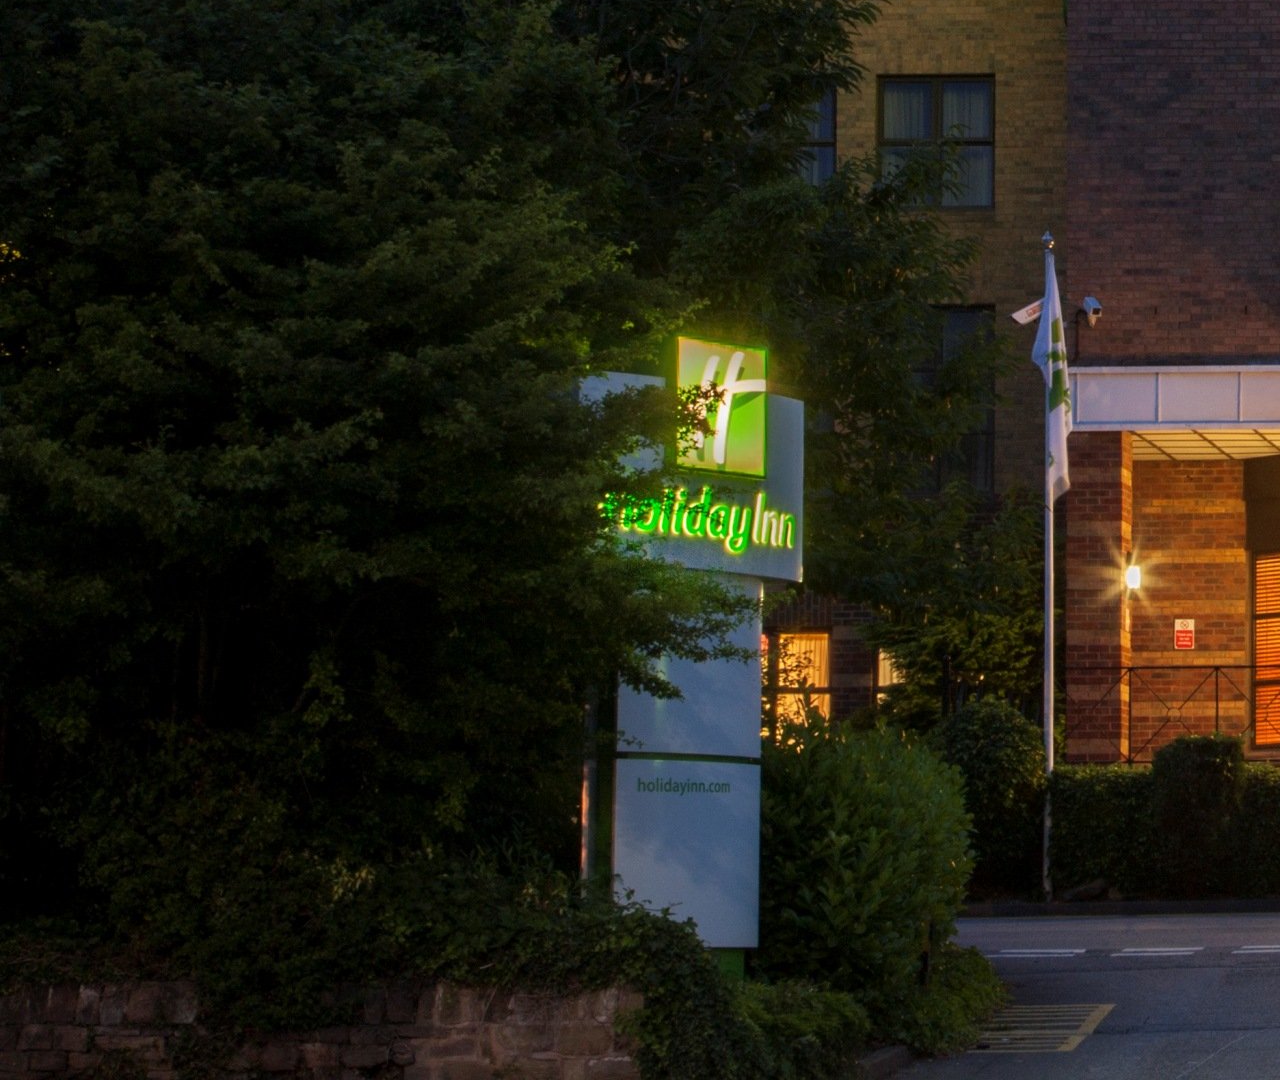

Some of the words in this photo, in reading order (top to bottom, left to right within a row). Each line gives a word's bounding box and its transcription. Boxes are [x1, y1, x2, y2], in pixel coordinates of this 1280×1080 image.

[597, 486, 752, 554] oliday
[752, 491, 796, 549] Inn
[637, 777, 731, 796] holidayinn.com
